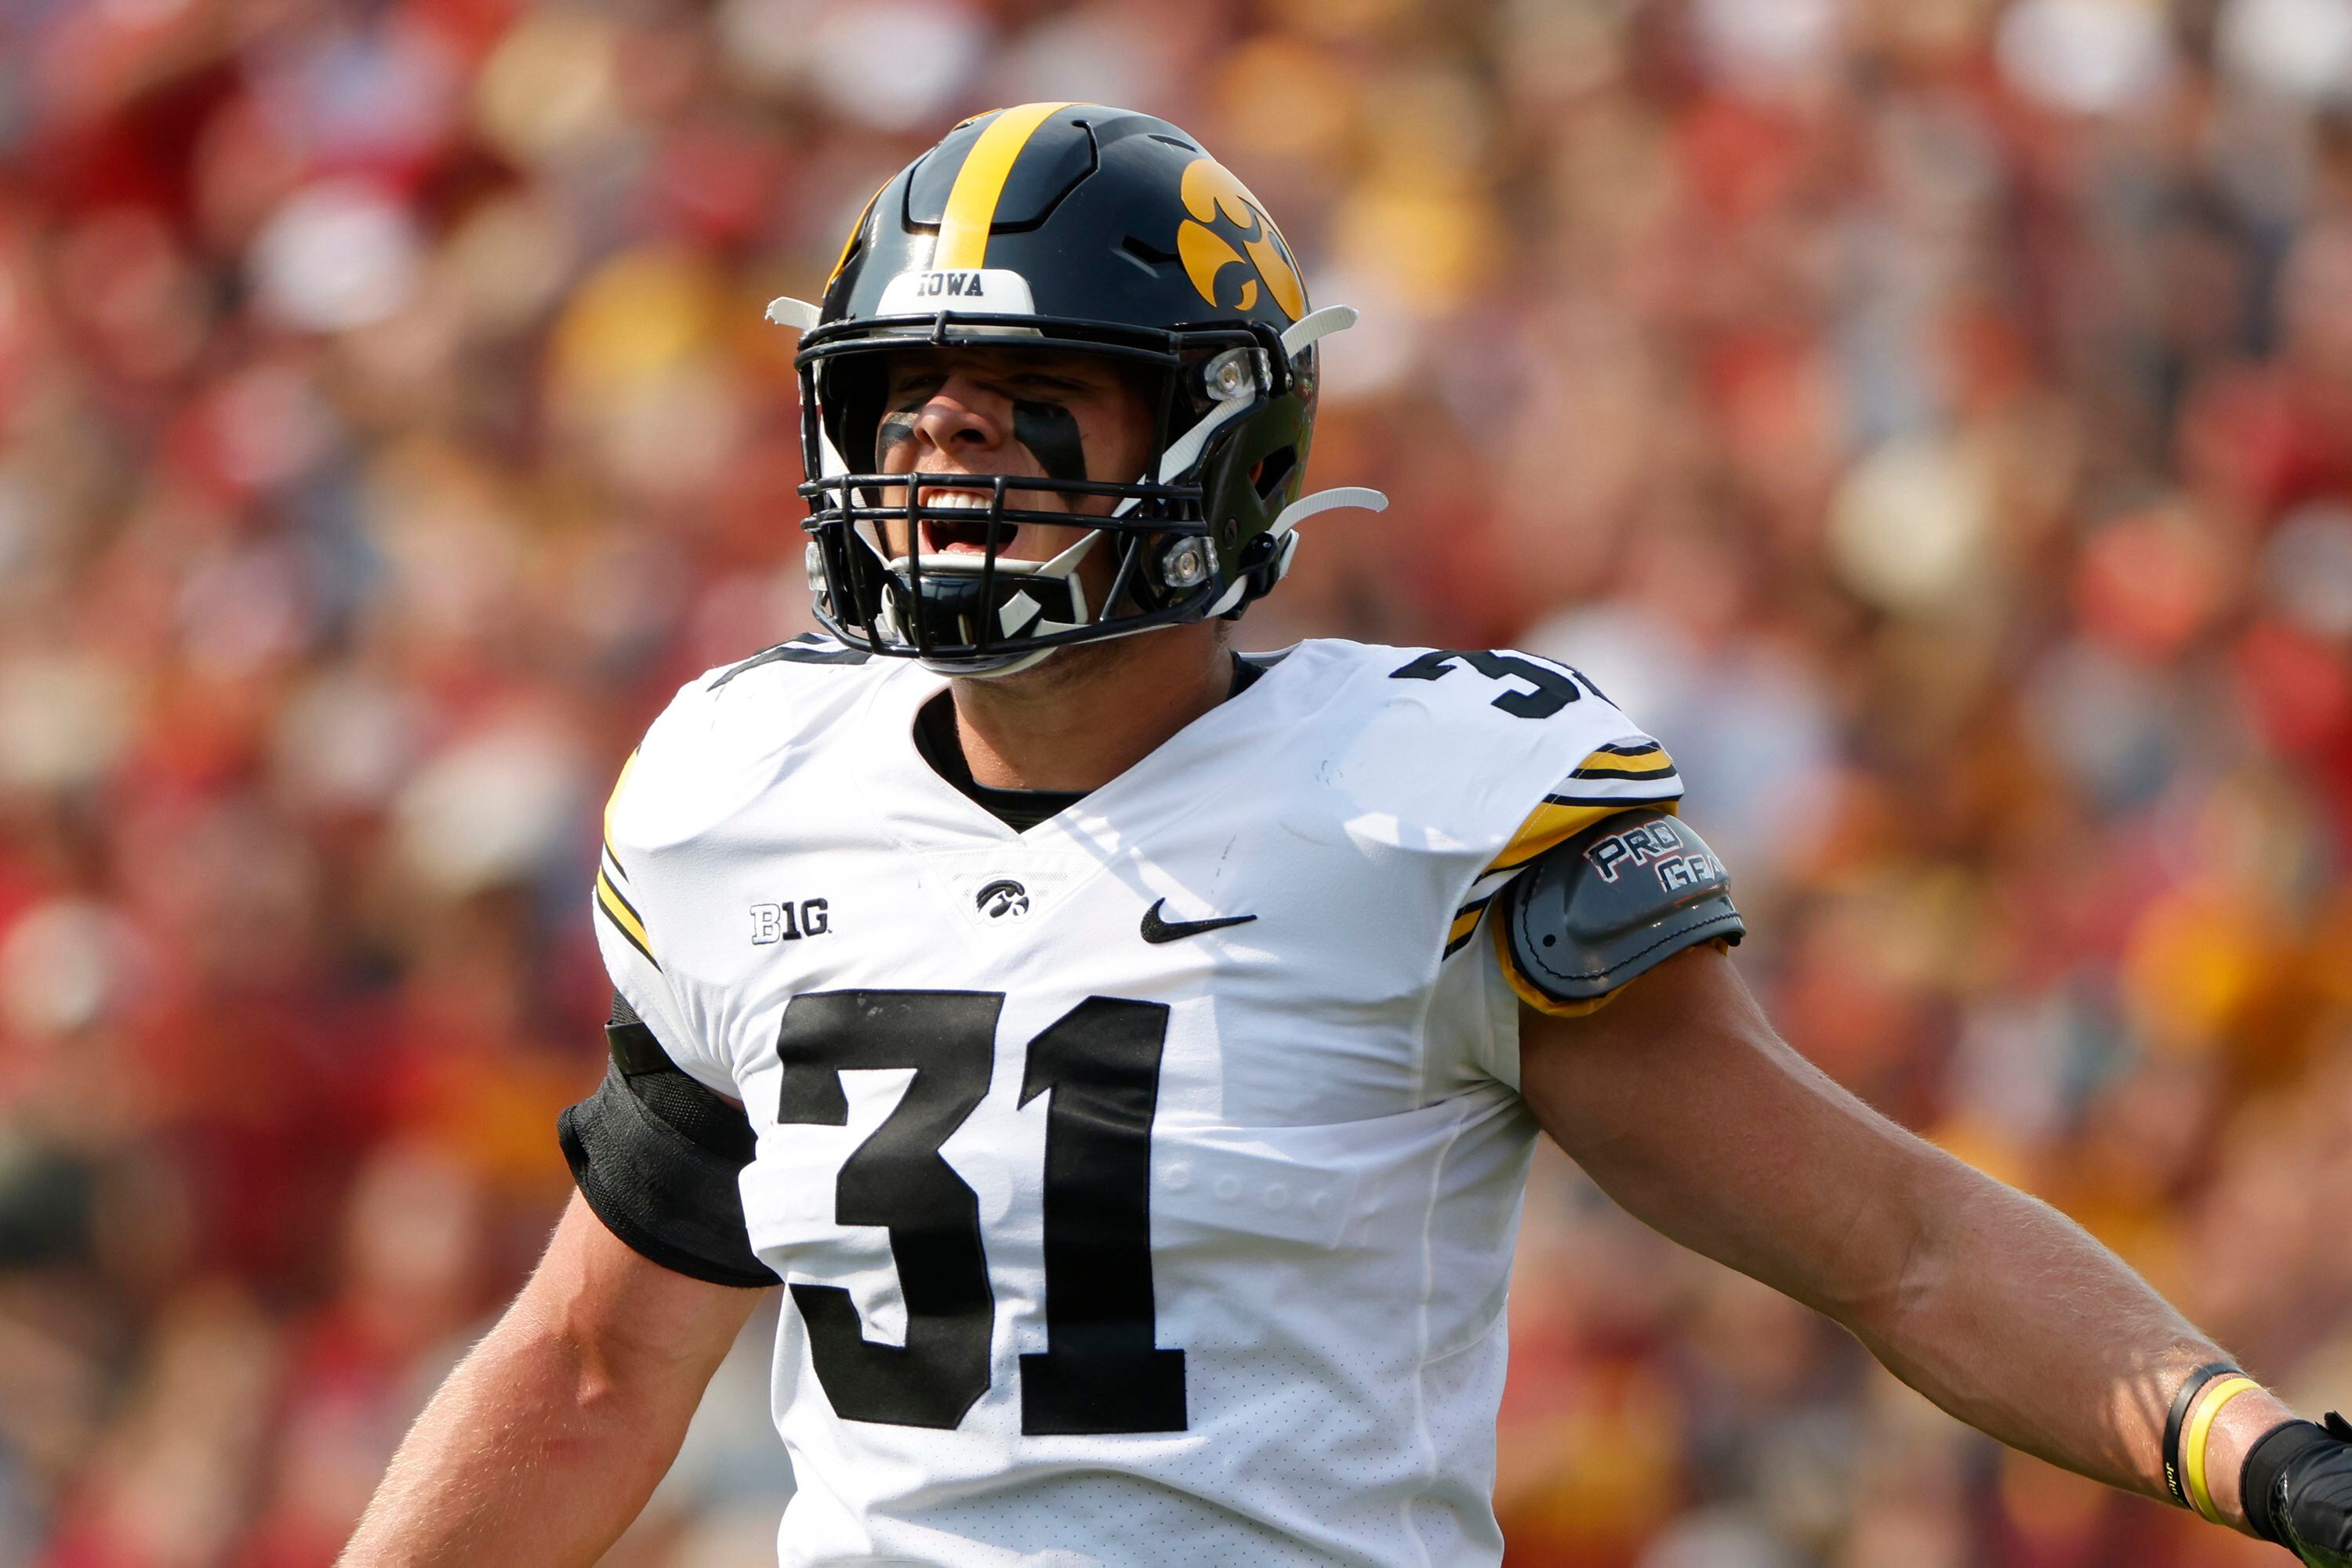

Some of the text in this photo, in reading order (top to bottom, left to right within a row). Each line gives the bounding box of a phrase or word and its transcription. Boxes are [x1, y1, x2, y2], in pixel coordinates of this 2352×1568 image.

[916, 273, 984, 296] IOWA
[1388, 648, 1621, 719] 3
[1583, 818, 1684, 884] PRO
[1654, 854, 1727, 894] GEA
[777, 989, 1188, 1436] 31
